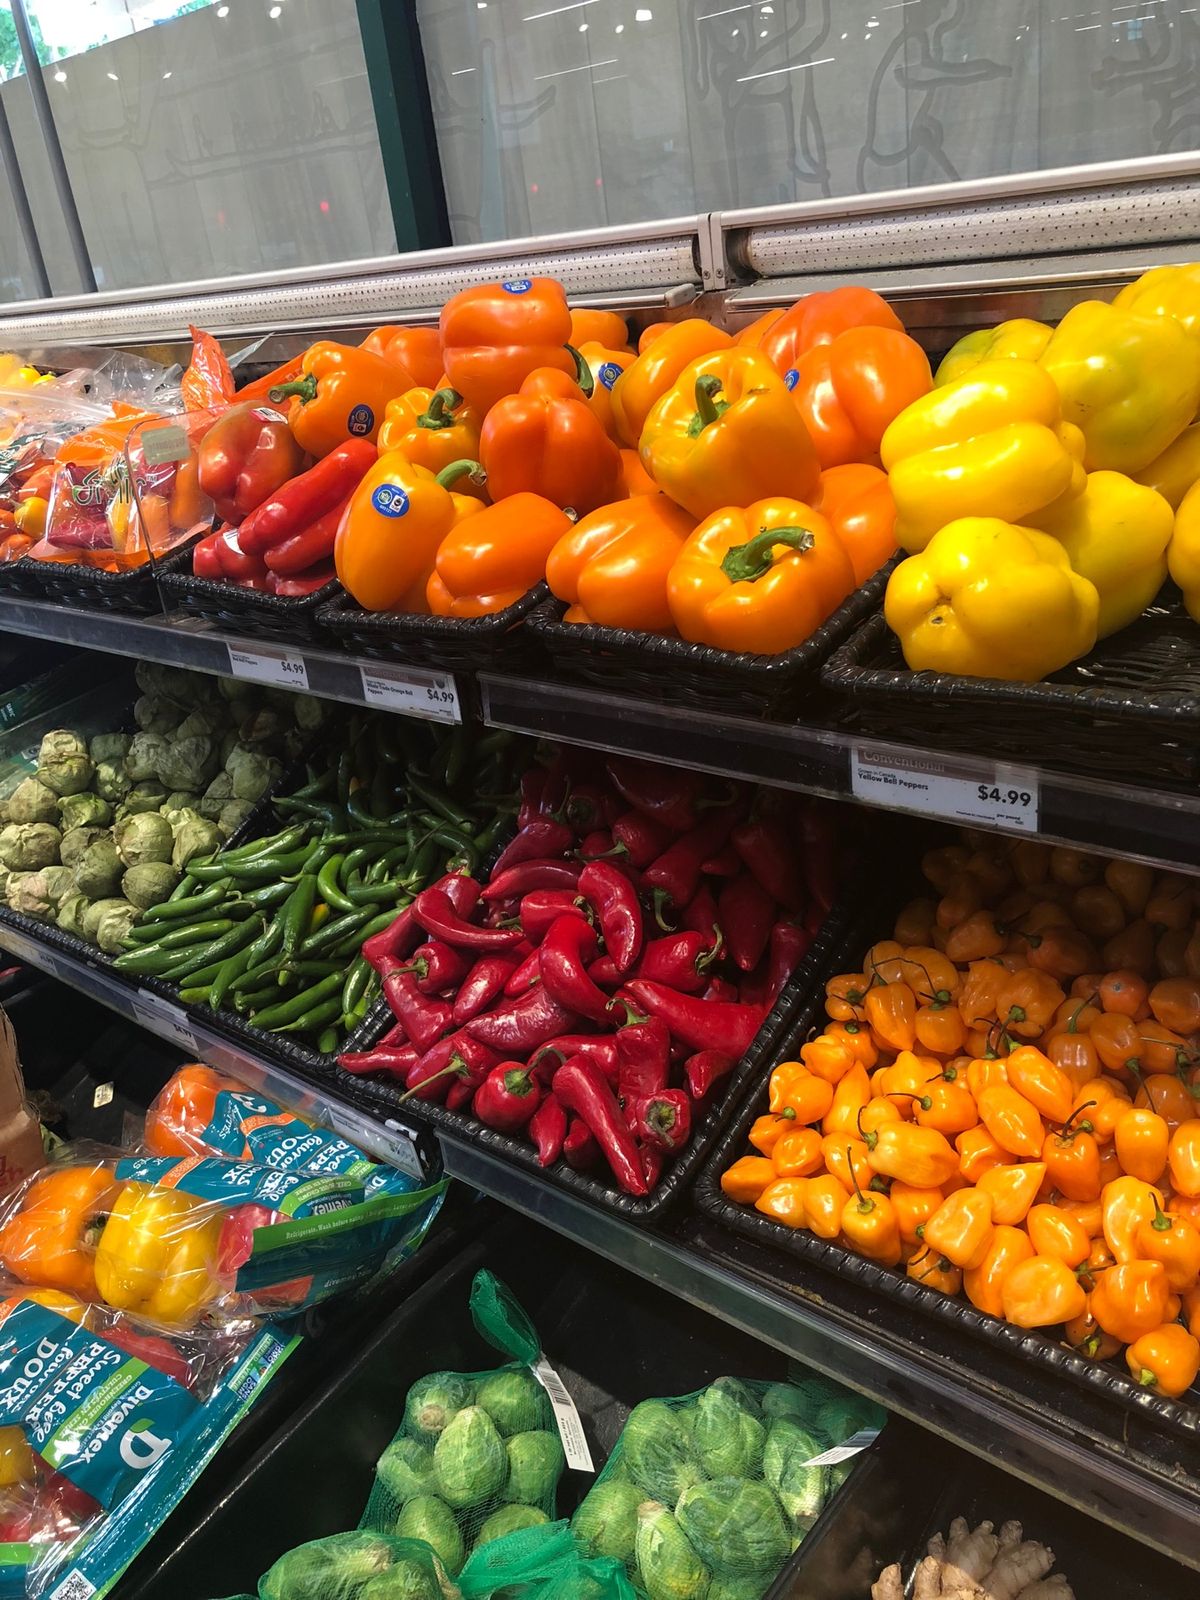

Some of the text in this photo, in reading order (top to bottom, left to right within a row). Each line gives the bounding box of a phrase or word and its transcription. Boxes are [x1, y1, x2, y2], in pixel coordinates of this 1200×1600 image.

[280, 661, 304, 675] $4.99
[427, 689, 454, 704] $4.99
[858, 773, 929, 791] Yellow Bell Peppers
[977, 784, 1031, 807] $4.99
[0, 1337, 59, 1409] DOUX
[67, 1349, 122, 1400] Sweet
[86, 1370, 133, 1423] GREENHOUSE
[80, 1385, 155, 1464] Divemex
